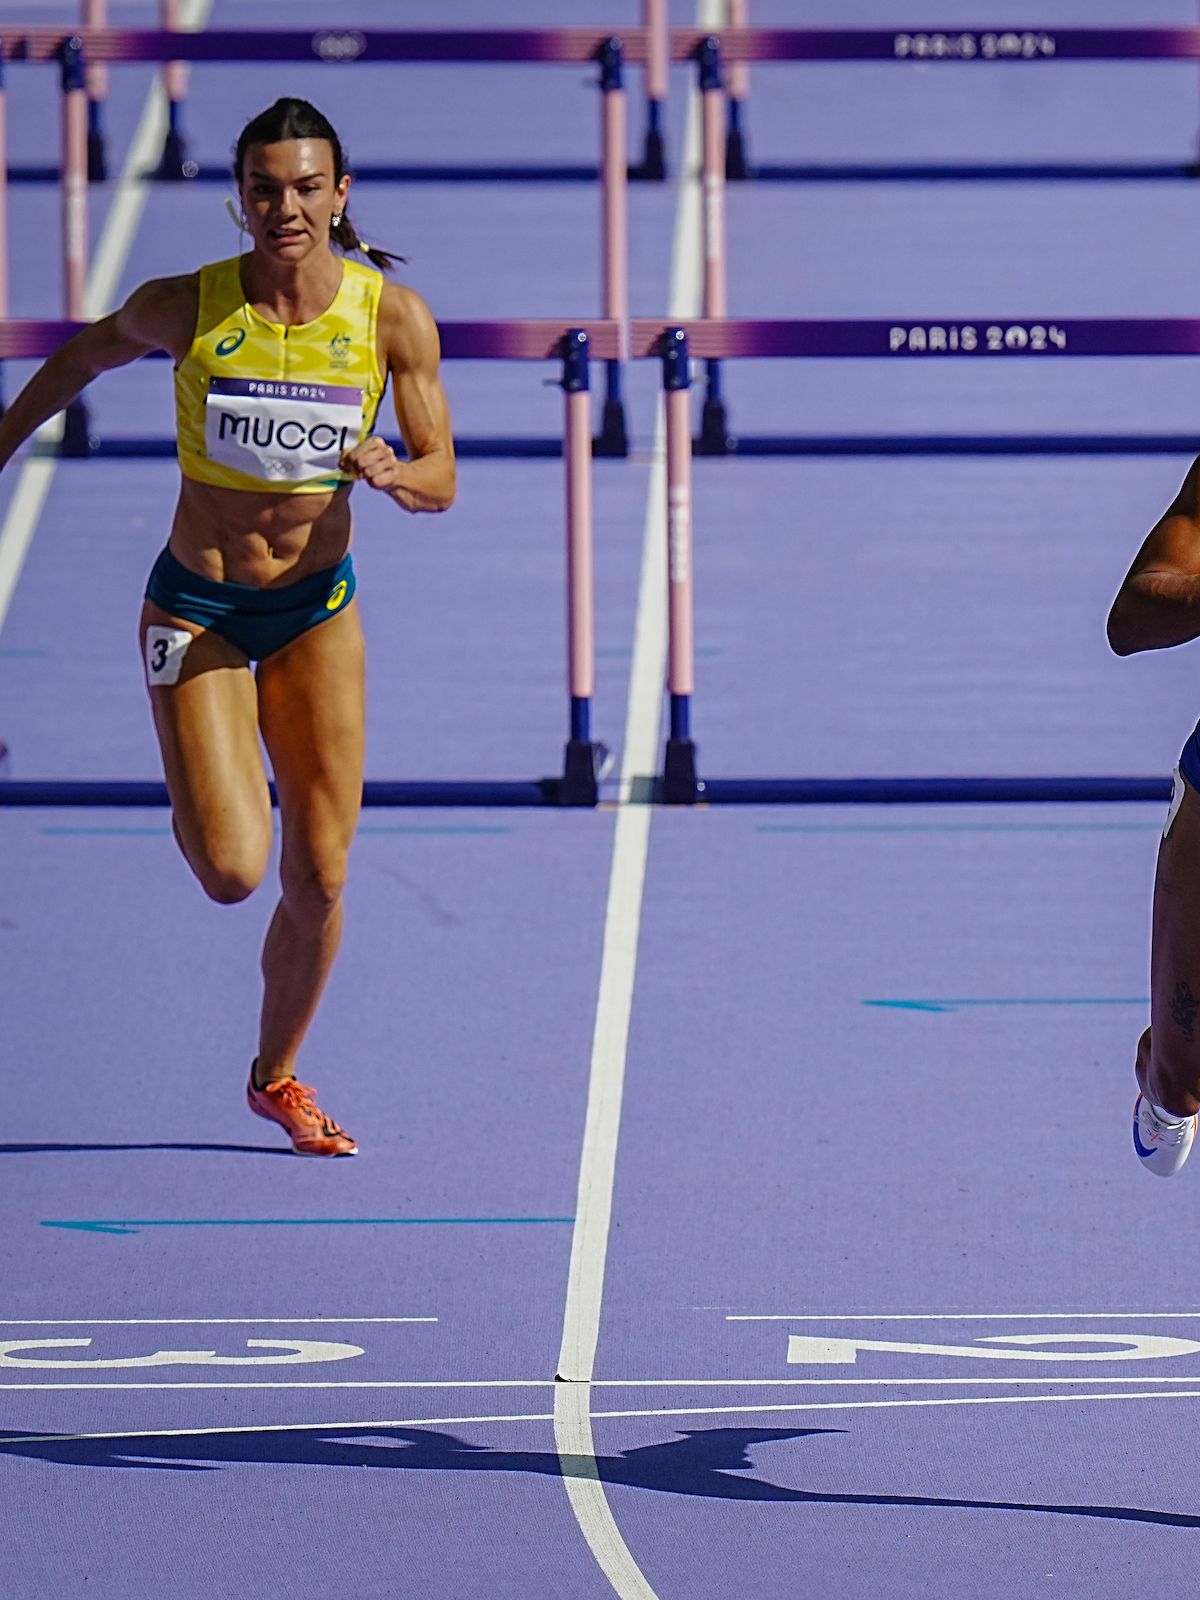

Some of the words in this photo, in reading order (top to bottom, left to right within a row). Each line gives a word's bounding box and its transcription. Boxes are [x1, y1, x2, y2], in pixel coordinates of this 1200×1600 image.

[894, 32, 978, 59] PARIS
[981, 32, 1056, 58] 2024
[889, 326, 978, 352] PARIS
[985, 325, 1067, 351] 2024
[248, 382, 288, 396] PARIS
[290, 385, 327, 399] 2024
[218, 411, 349, 452] MUCCI
[151, 638, 168, 673] 3
